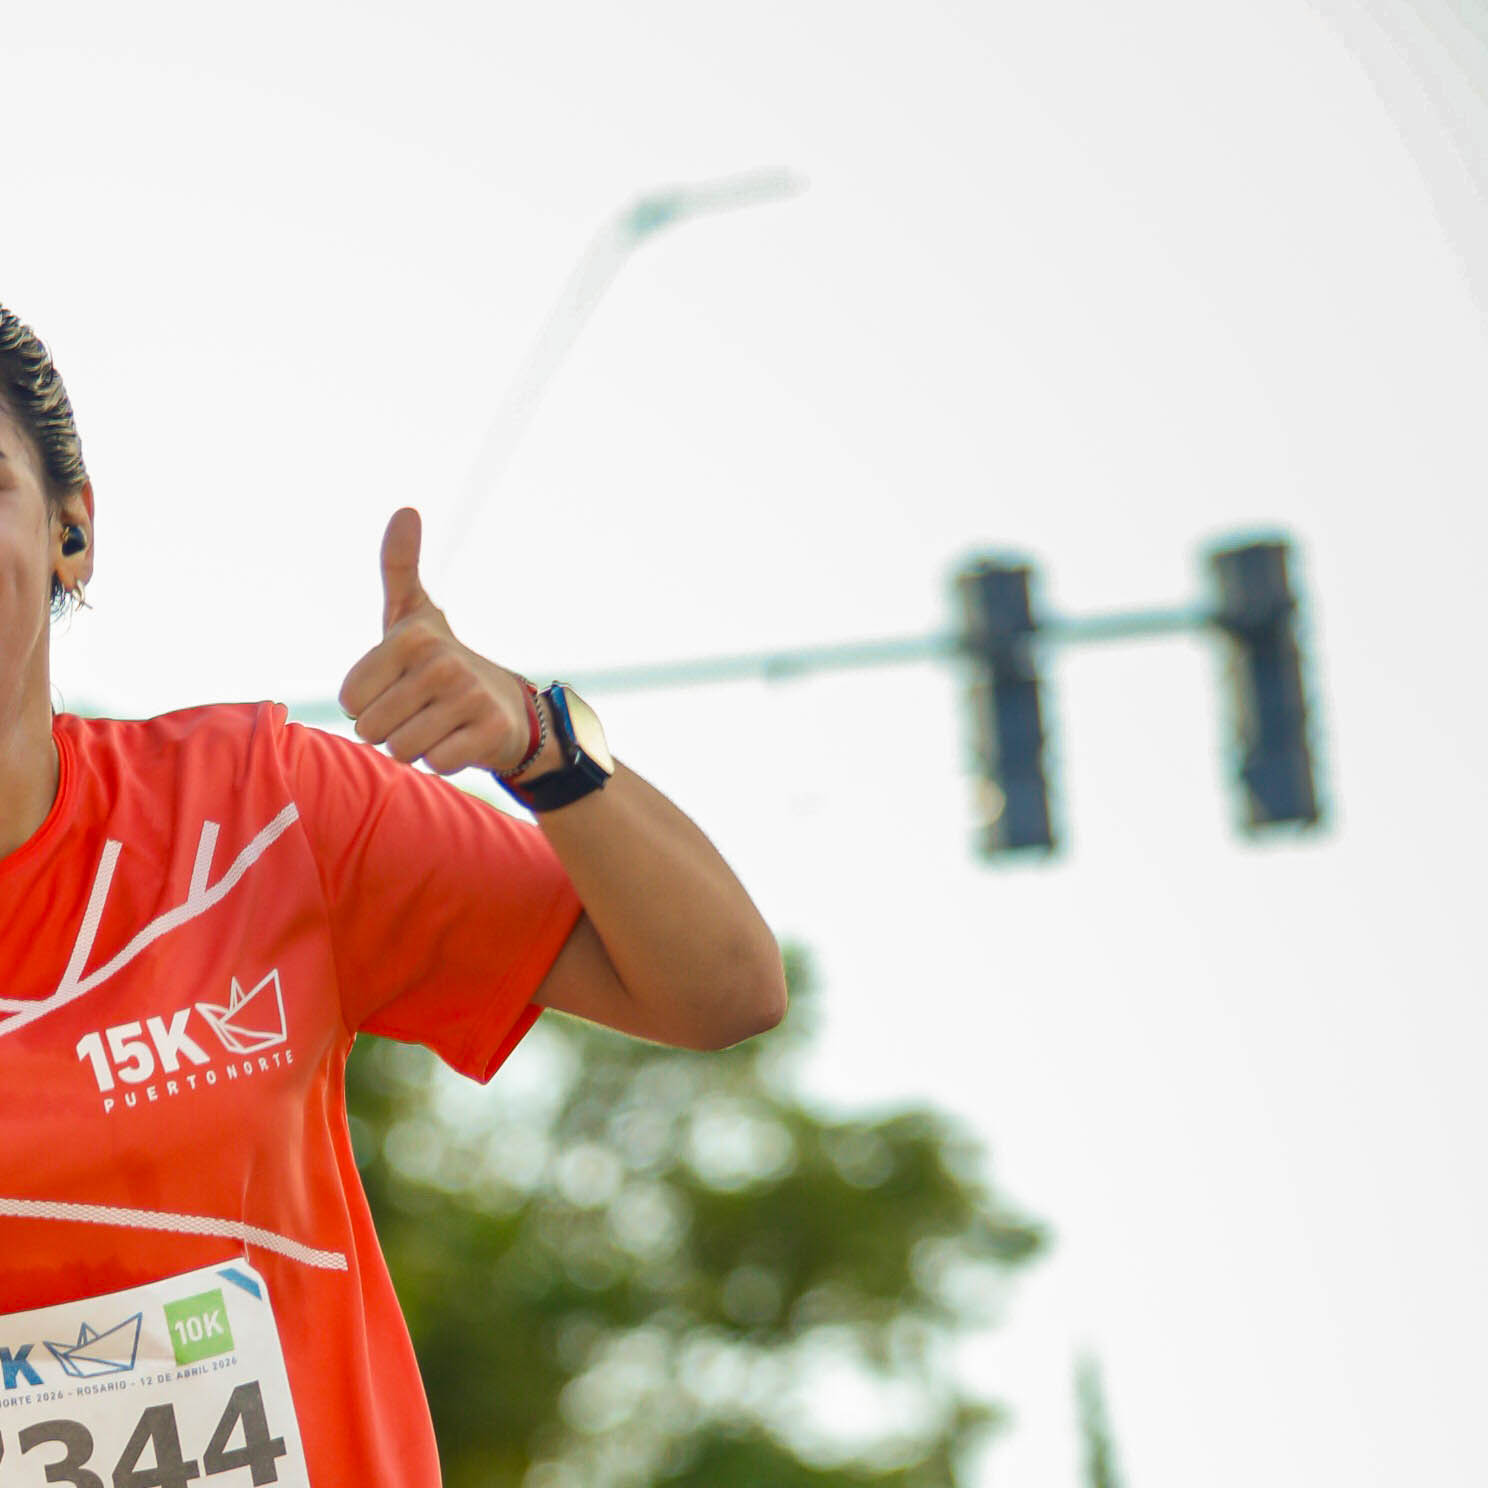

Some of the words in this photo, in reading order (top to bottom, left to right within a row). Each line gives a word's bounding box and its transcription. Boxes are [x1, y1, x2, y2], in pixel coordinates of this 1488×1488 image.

[76, 1008, 210, 1092] 15K
[174, 1309, 223, 1345] 10K
[77, 1380, 127, 1398] ROSARIO
[140, 1376, 153, 1387] 12
[157, 1372, 172, 1384] DE
[177, 1363, 209, 1380] ABRIL
